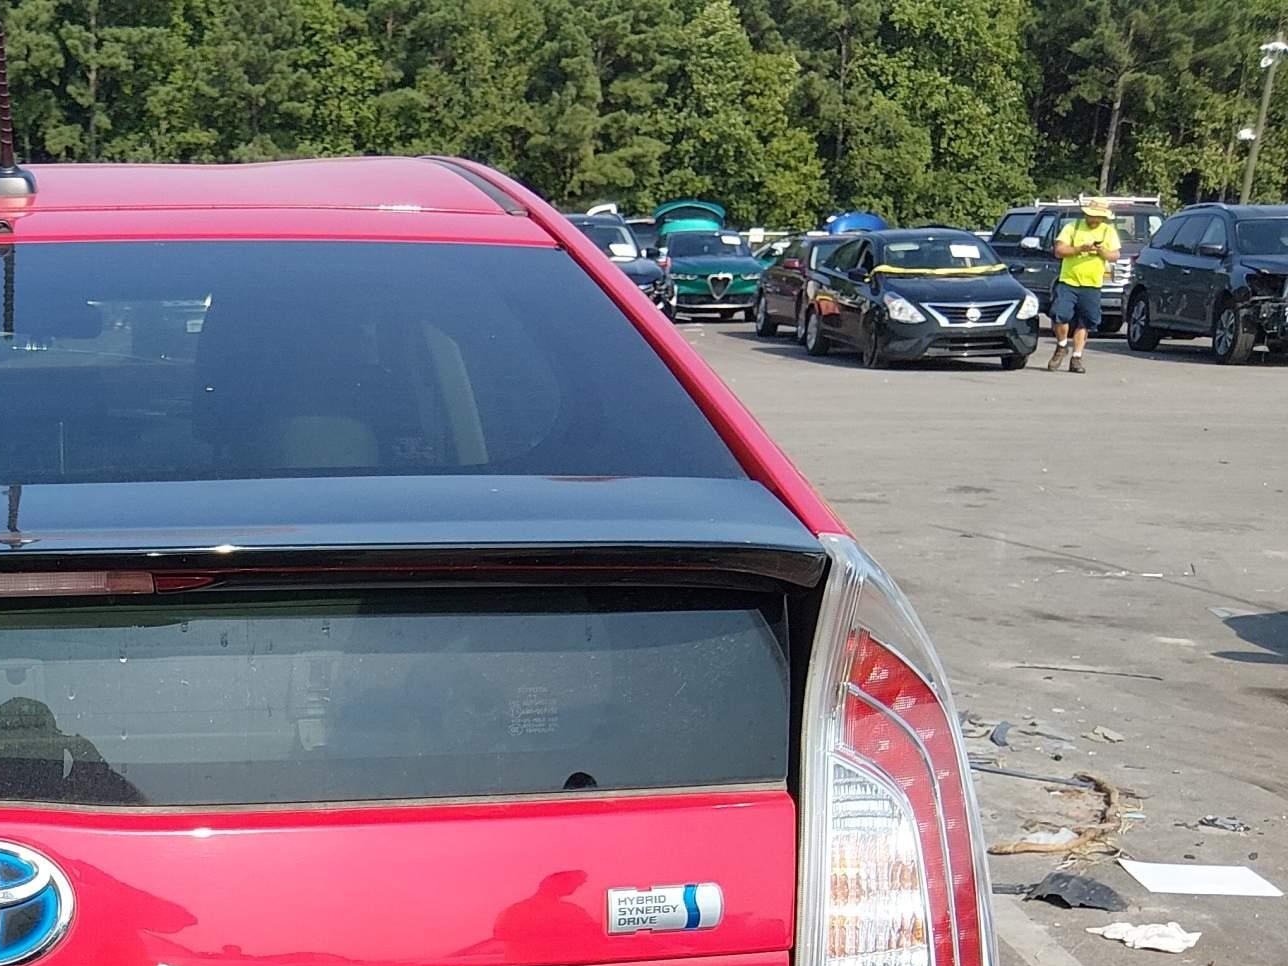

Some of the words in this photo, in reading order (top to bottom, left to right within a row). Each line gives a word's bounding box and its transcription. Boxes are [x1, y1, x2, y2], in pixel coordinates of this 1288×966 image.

[618, 895, 666, 906] HYBRID
[618, 904, 679, 916] SYNERGY
[618, 916, 657, 926] DRIVE
